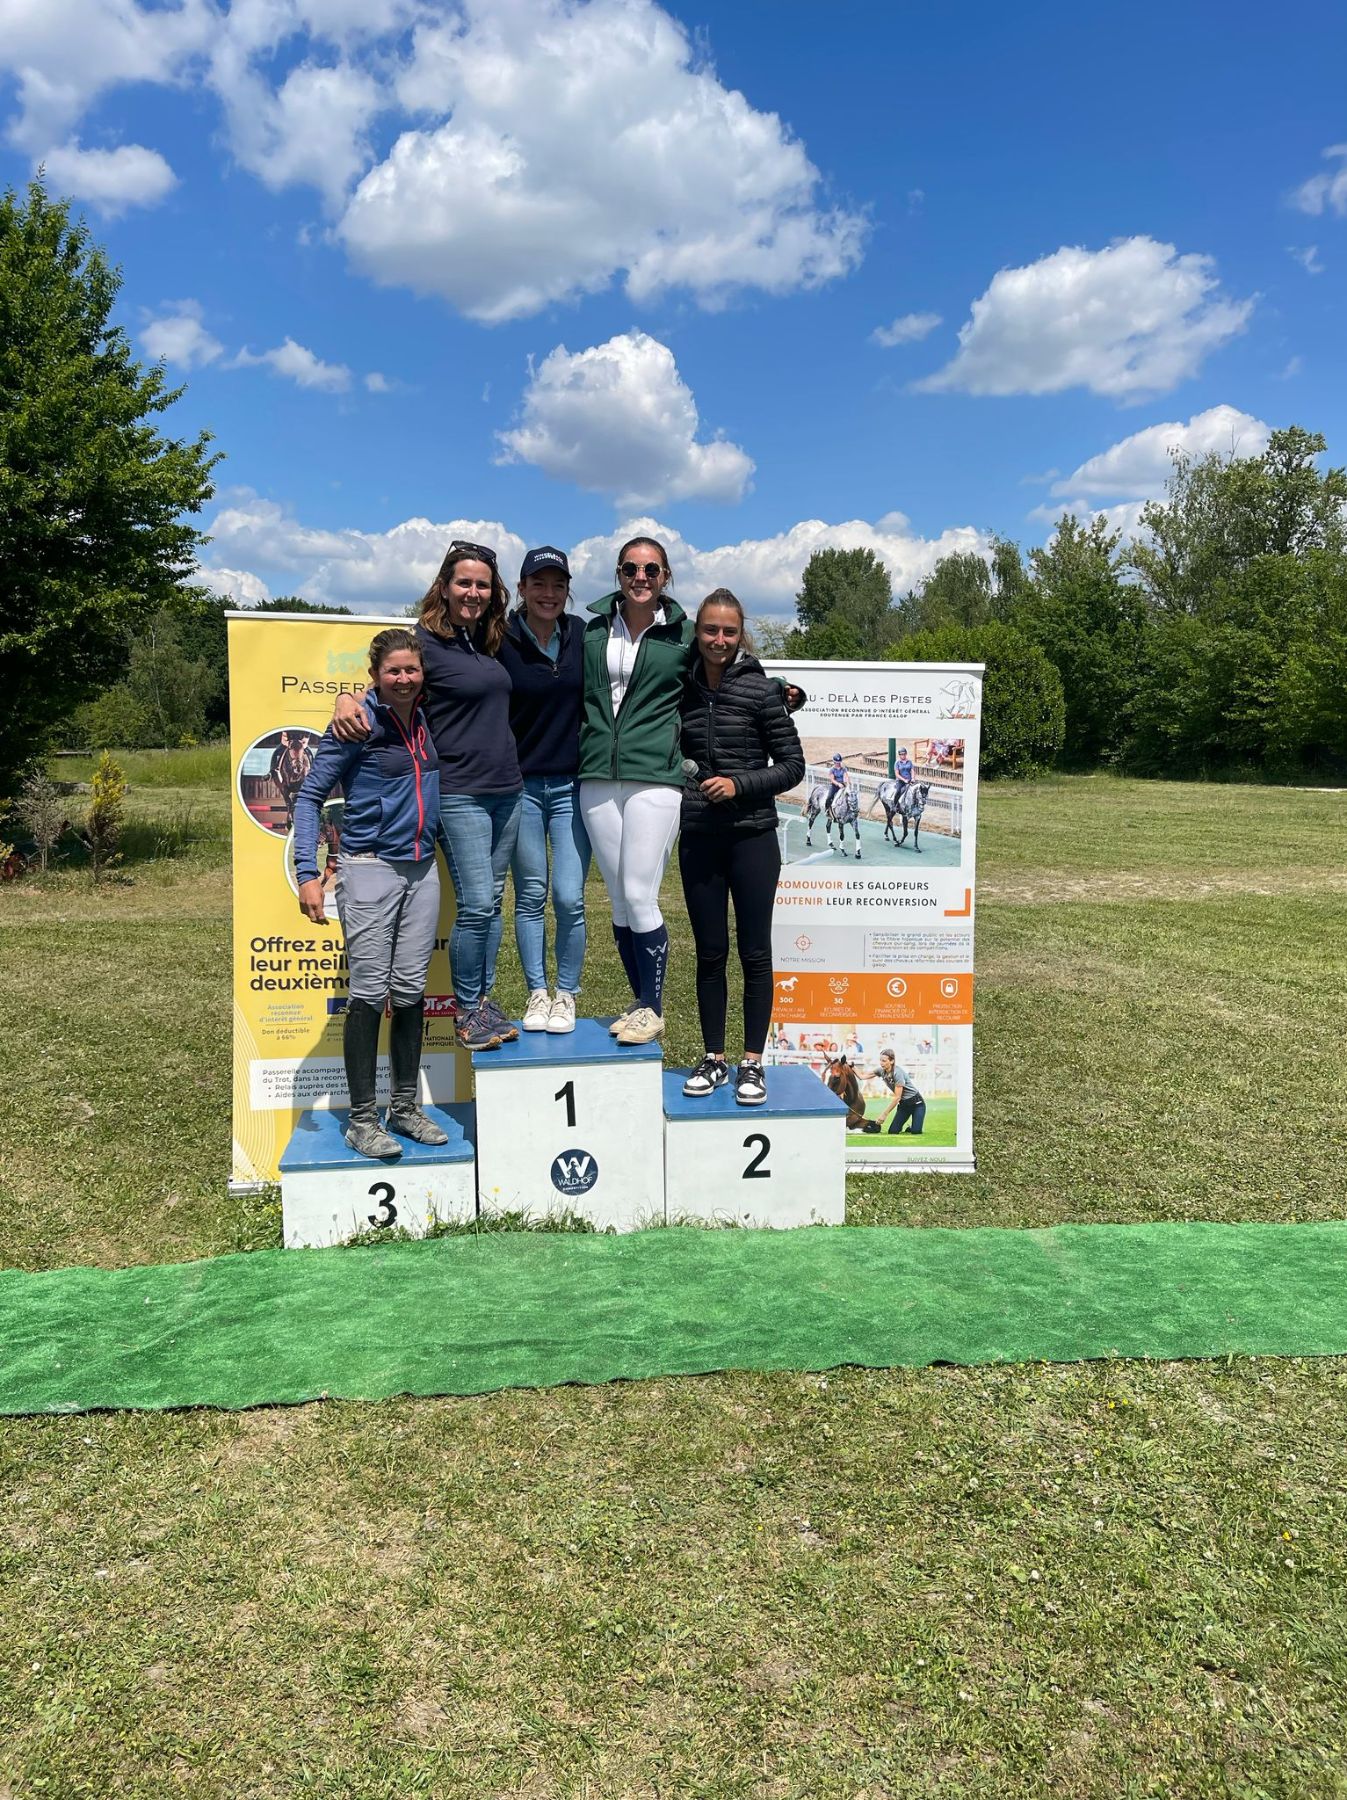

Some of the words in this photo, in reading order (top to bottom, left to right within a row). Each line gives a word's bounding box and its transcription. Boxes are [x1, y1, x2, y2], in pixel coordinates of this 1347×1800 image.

[281, 676, 365, 694] PASSER
[828, 692, 859, 702] DELÀ
[890, 694, 932, 704] PISTES
[777, 880, 843, 890] ROMOUVOIR
[846, 881, 864, 890] LES
[867, 882, 929, 890] GALOPEURS
[776, 896, 823, 905] OUTENIR
[826, 897, 852, 906] LEUR
[856, 898, 938, 906] RECONVERSION
[250, 936, 316, 953] Offrez
[322, 940, 346, 952] au
[250, 956, 292, 972] leur
[298, 954, 349, 971] meill
[554, 1080, 576, 1127] 1
[742, 1133, 771, 1179] 2
[558, 1177, 592, 1186] WALDHOF
[368, 1182, 398, 1229] 3
